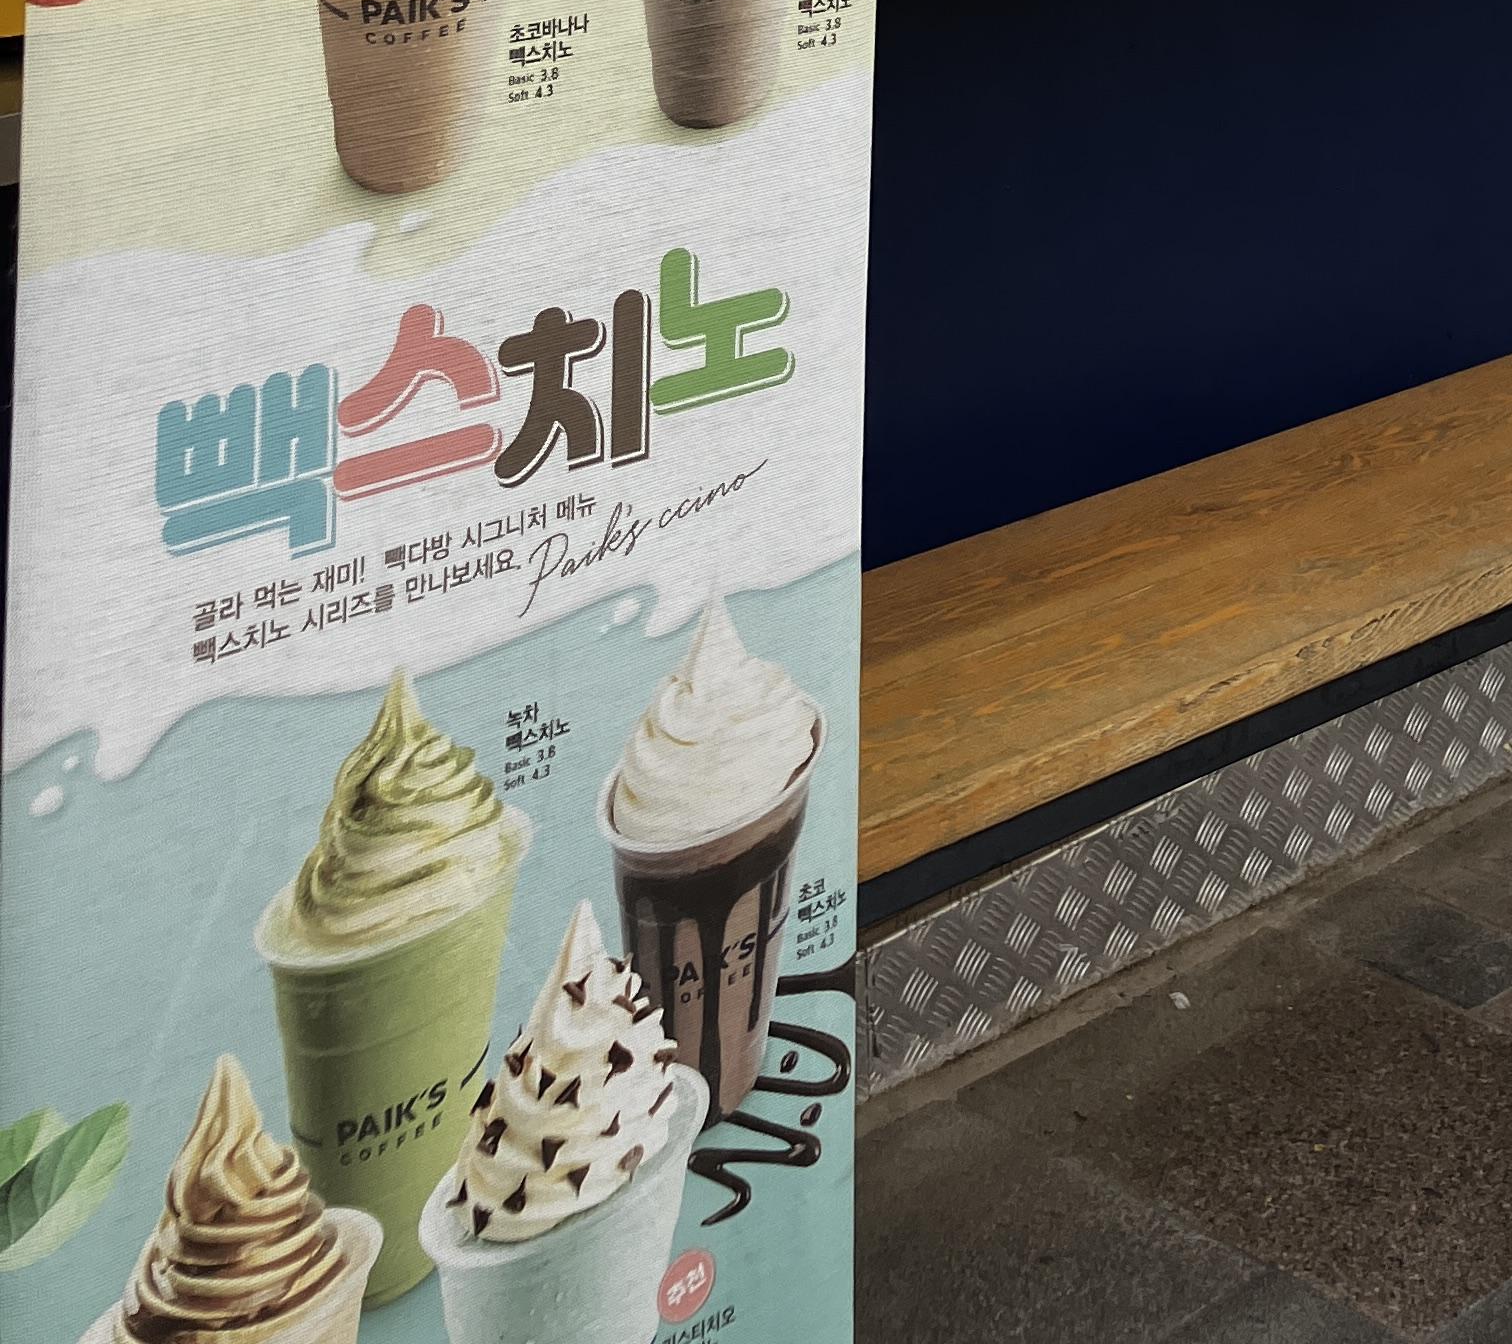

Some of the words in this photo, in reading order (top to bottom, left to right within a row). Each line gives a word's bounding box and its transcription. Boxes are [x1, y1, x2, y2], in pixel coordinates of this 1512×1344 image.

[365, 18, 467, 45] COFFEE
[509, 13, 590, 43] 초코바나나
[825, 16, 842, 32] 3.8
[797, 37, 816, 50] Soft
[820, 33, 837, 47] 4.3
[508, 73, 535, 86] Basic
[540, 67, 559, 83] 3.8
[508, 90, 529, 104] Soft
[535, 83, 554, 98] 4.3
[156, 247, 795, 560] 빽스치노
[517, 501, 653, 618] Paik's
[658, 457, 769, 530] ccino
[192, 591, 244, 632] 골라
[253, 579, 303, 609] 먹는
[311, 555, 367, 593] 재미!
[461, 503, 548, 549] 시그니처
[556, 492, 598, 522] 메뉴
[191, 618, 292, 664] 빽스치노
[300, 582, 396, 633] 시리즈를
[506, 701, 540, 729] 녹차
[503, 774, 525, 791] Soft
[531, 764, 551, 780] 4.3
[798, 878, 826, 904] 초코
[336, 1077, 449, 1147] PAIK'S
[340, 1111, 444, 1167] COFFEE
